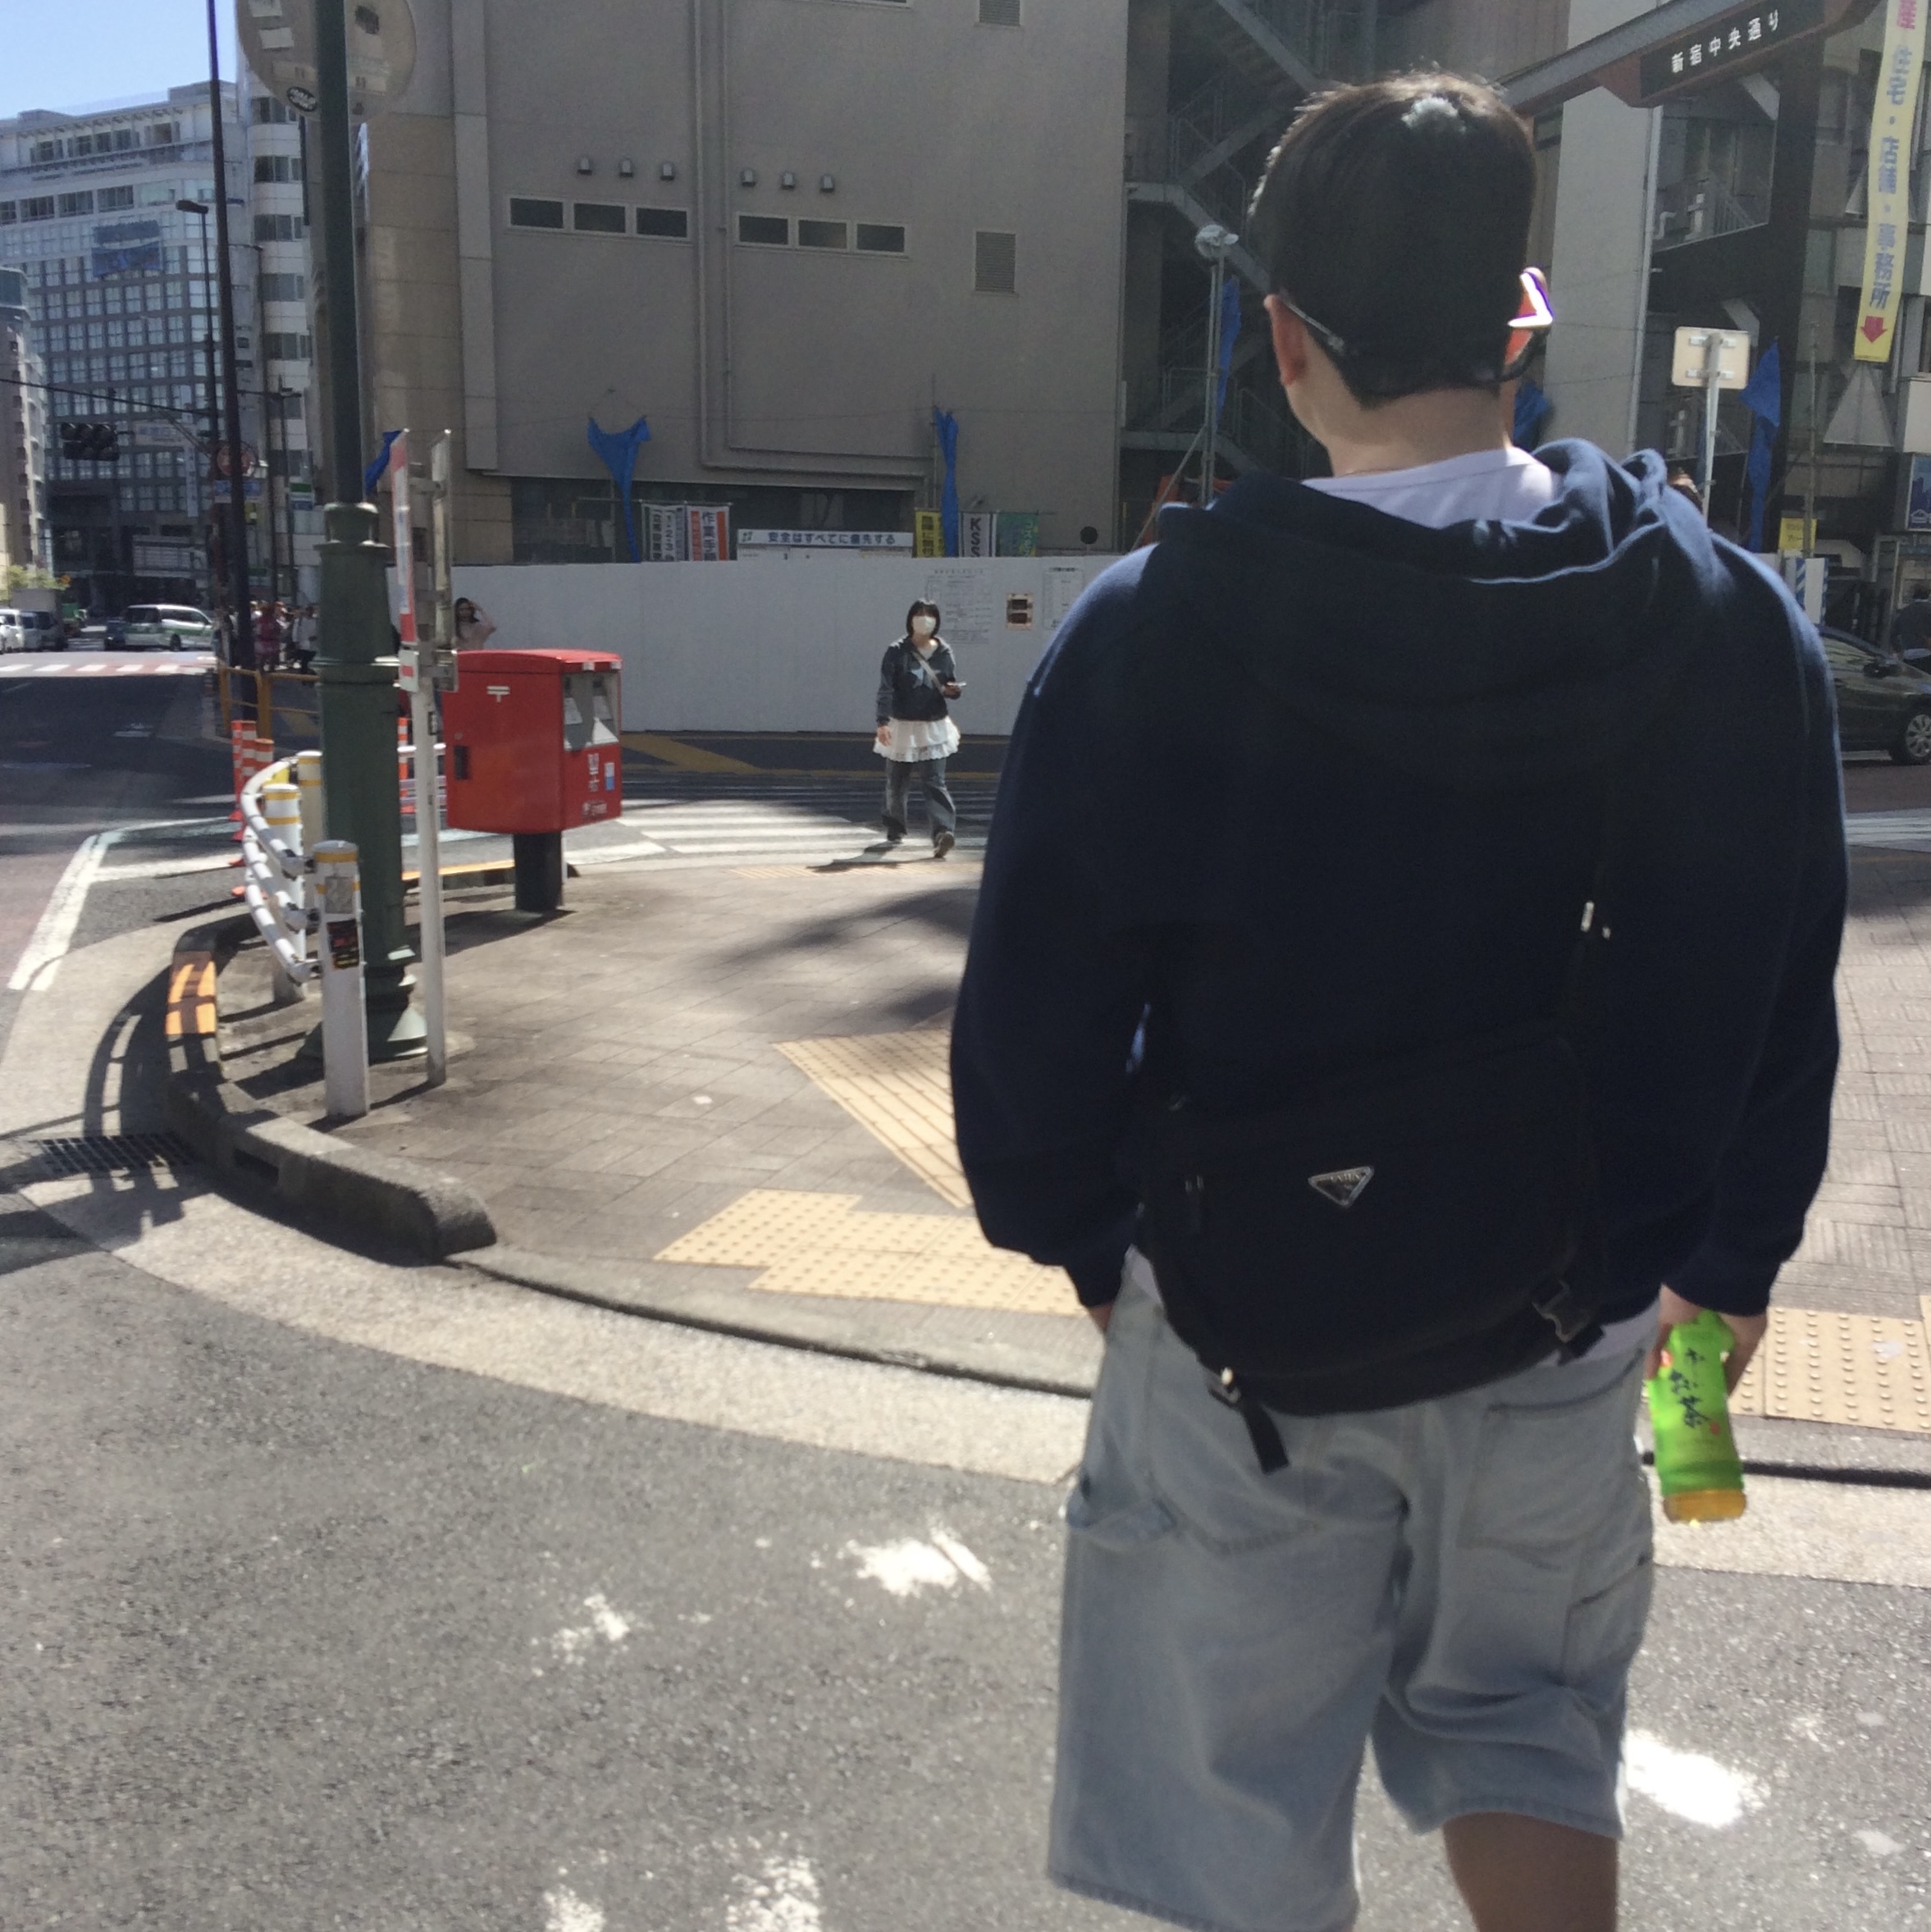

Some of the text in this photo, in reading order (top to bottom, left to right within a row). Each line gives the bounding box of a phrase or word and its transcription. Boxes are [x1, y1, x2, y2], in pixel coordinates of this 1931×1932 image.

[1671, 9, 1779, 74] 新宿中央通り
[768, 532, 896, 546] 安全はすべてに優先する
